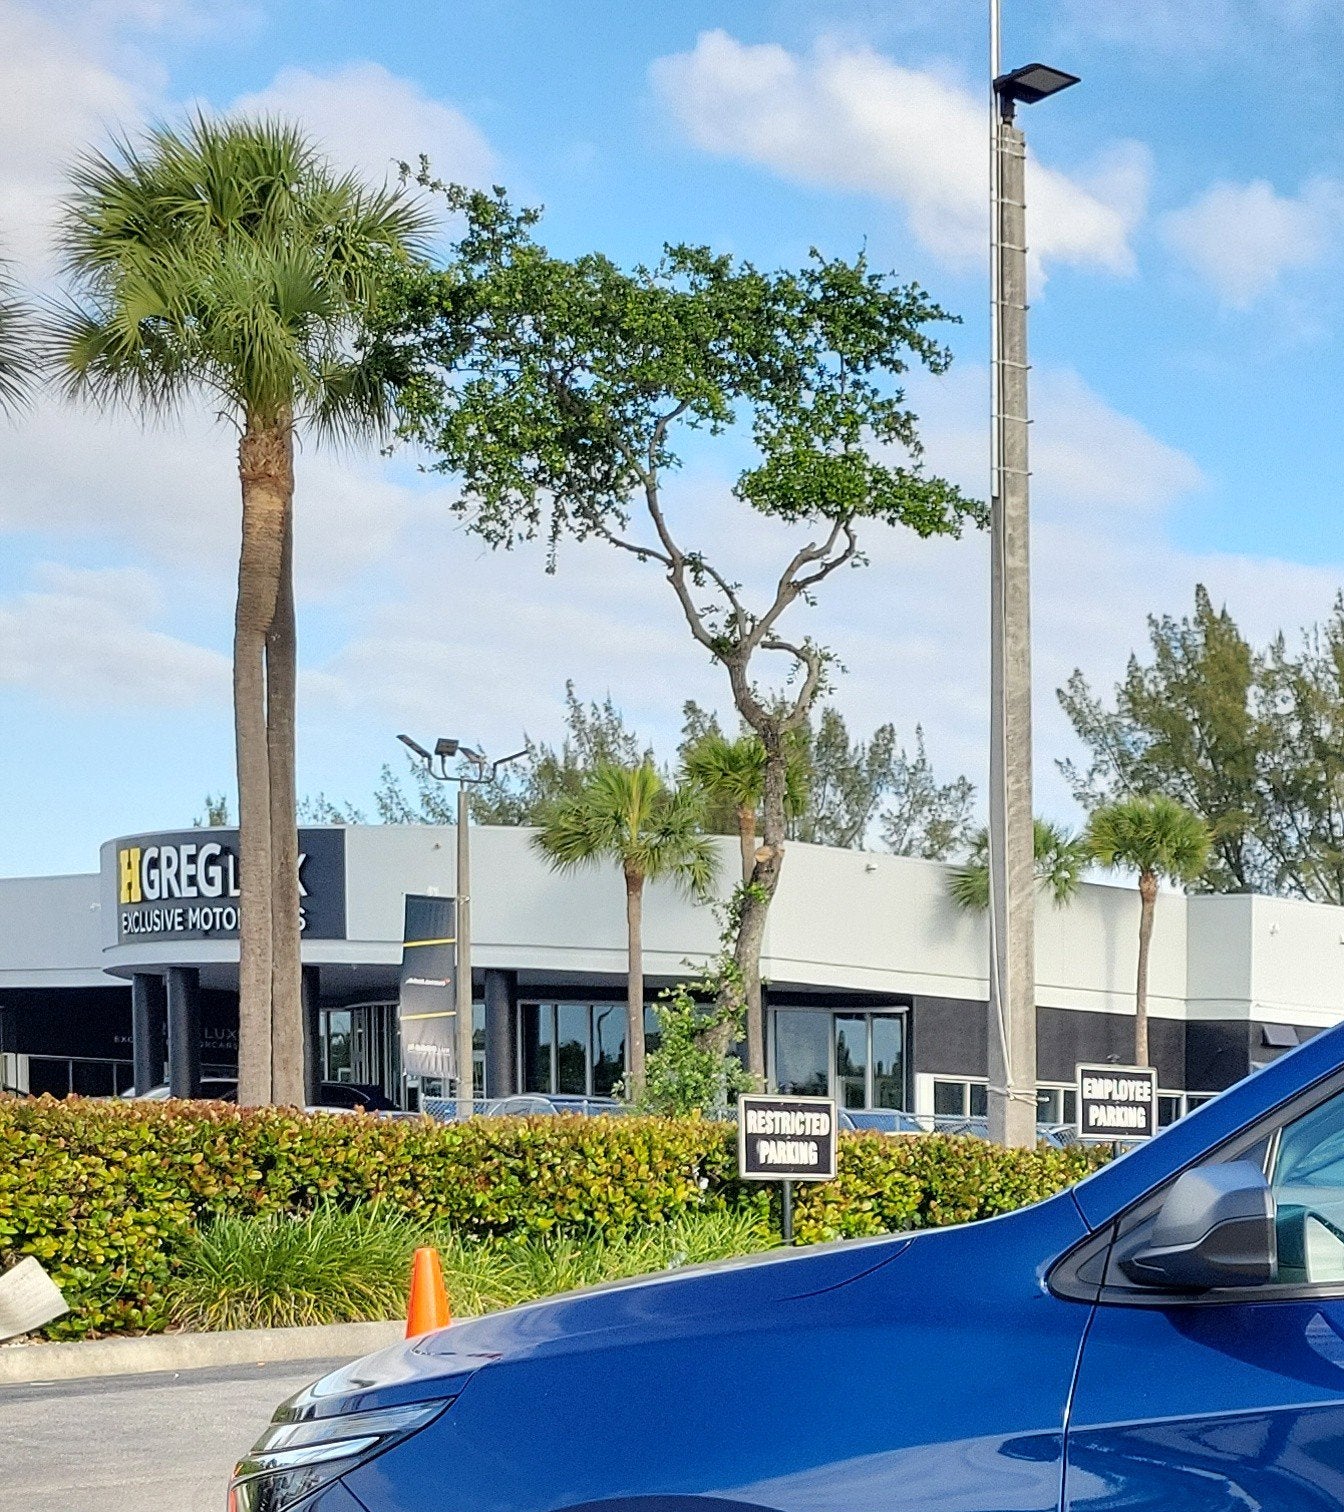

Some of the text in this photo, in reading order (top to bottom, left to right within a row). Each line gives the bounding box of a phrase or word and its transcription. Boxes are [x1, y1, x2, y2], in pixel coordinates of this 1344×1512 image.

[122, 906, 306, 934] EXCLUSIVE MOTOS
[1082, 1077, 1151, 1102] EMPLOYEE
[746, 1109, 830, 1136] RESTRICTED
[1088, 1104, 1146, 1128] PARKING
[759, 1140, 818, 1165] PARKING
